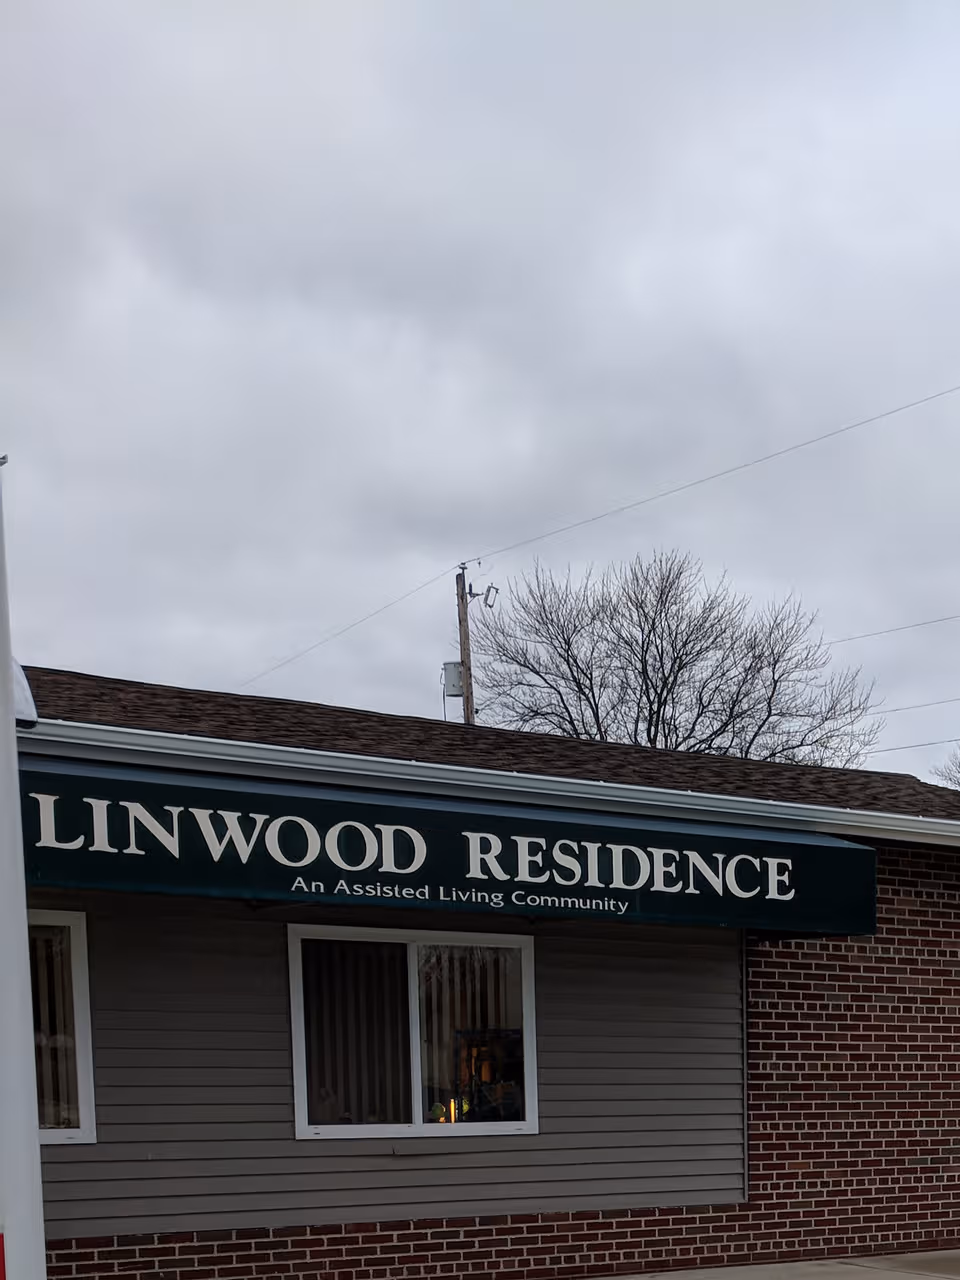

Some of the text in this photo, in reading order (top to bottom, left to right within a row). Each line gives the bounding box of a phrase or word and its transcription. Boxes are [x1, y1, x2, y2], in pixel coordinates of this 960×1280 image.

[29, 792, 796, 901] LINWOOD RESIDENCE
[290, 876, 629, 915] An Assisted Living Community
